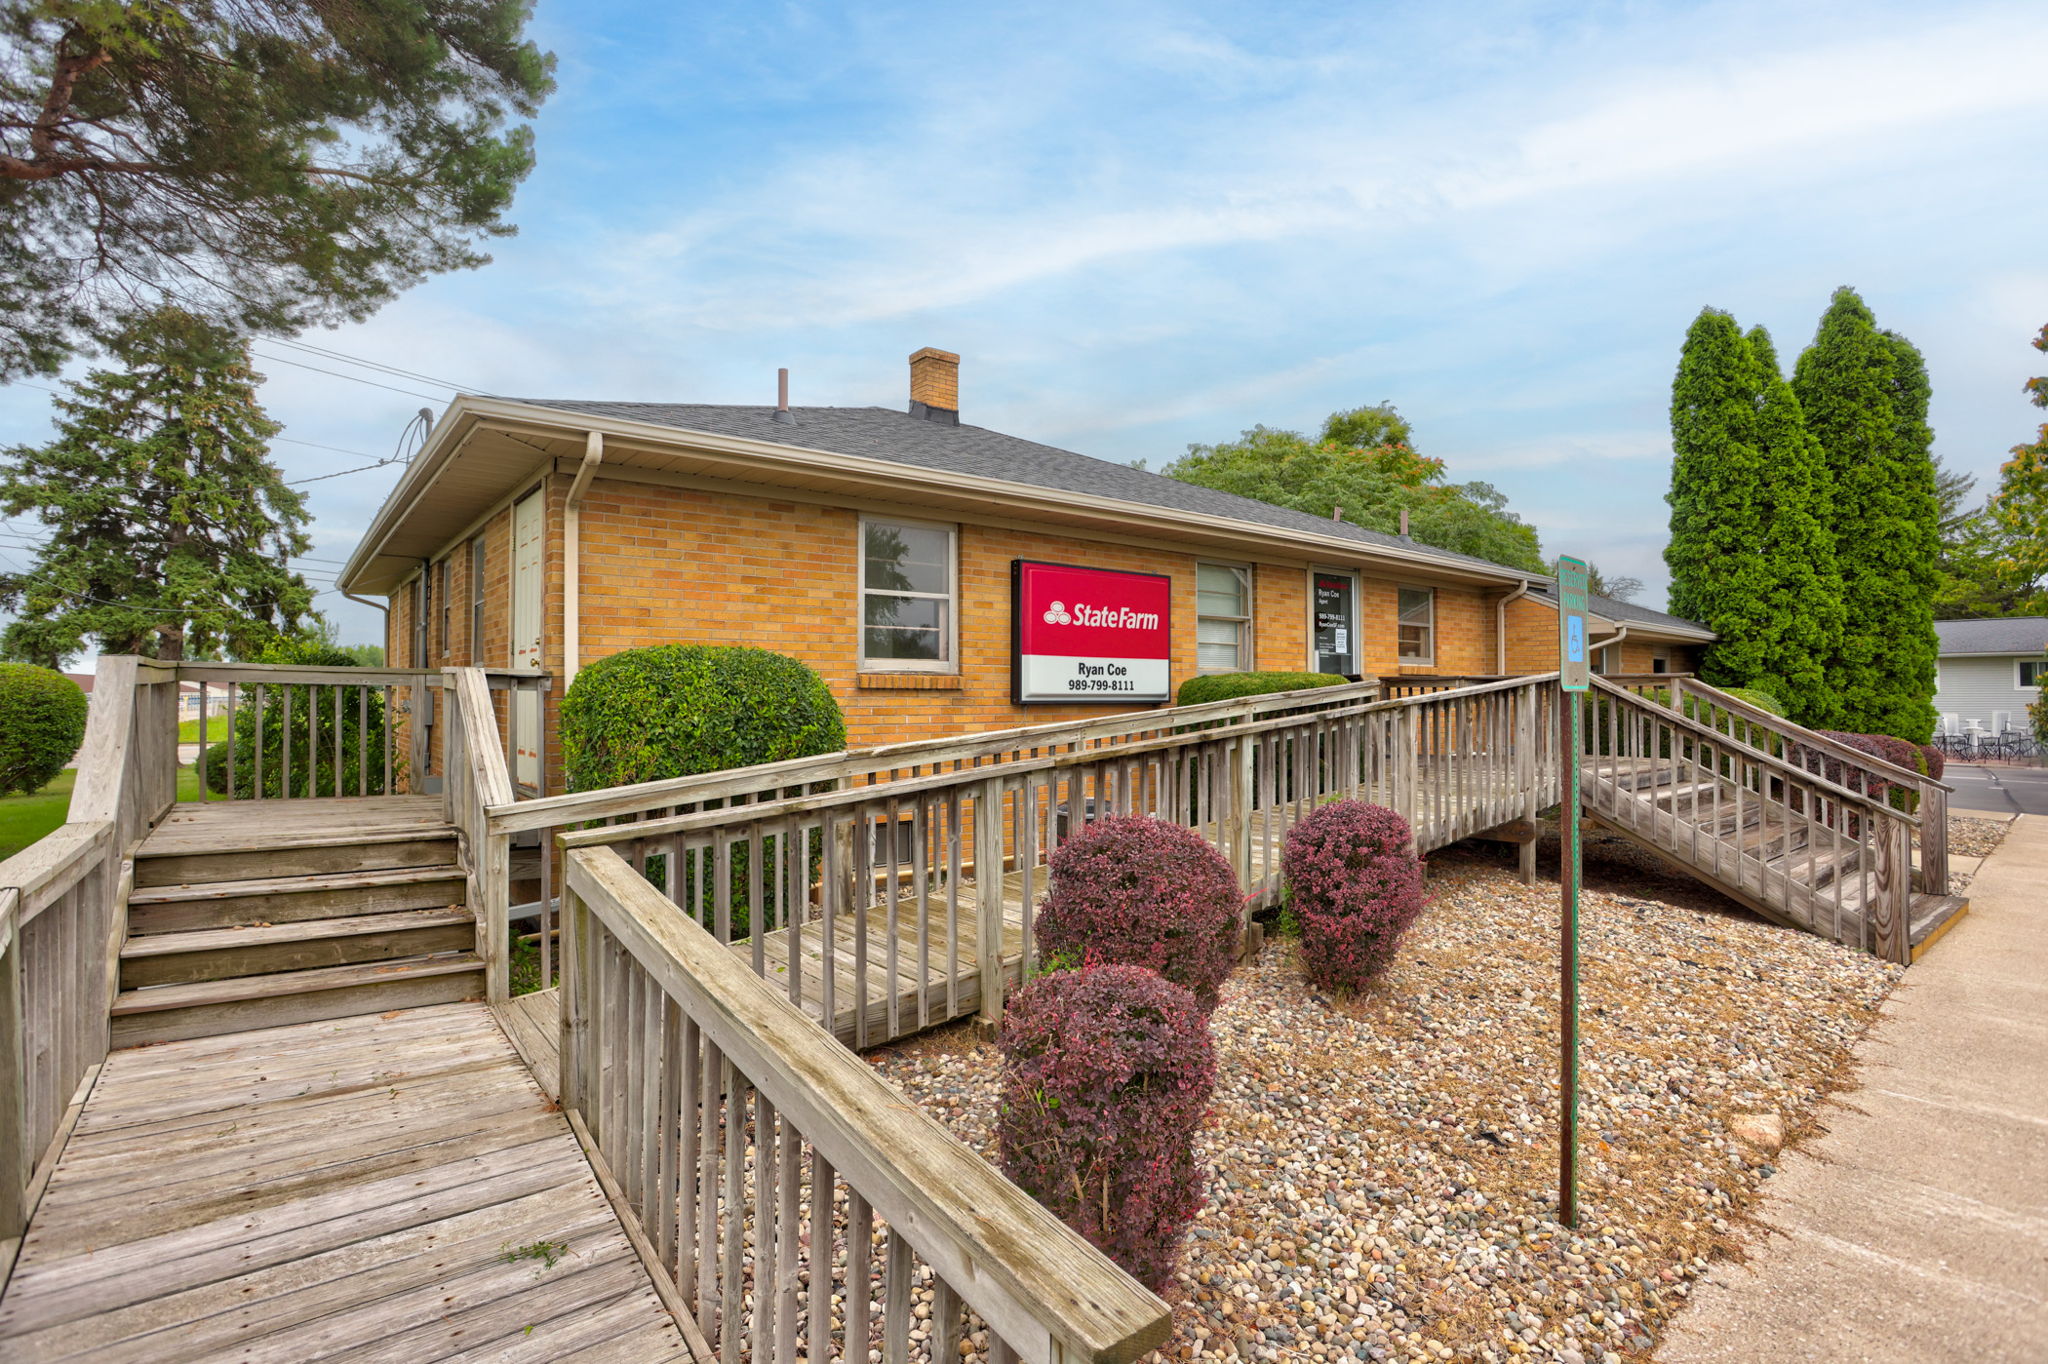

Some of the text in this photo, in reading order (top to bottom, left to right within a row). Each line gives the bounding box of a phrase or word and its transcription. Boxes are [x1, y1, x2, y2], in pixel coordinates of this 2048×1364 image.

[1563, 591, 1585, 611] PARKING
[1078, 662, 1127, 678] Ryan Coe
[1068, 679, 1135, 691] 989-799-8111
